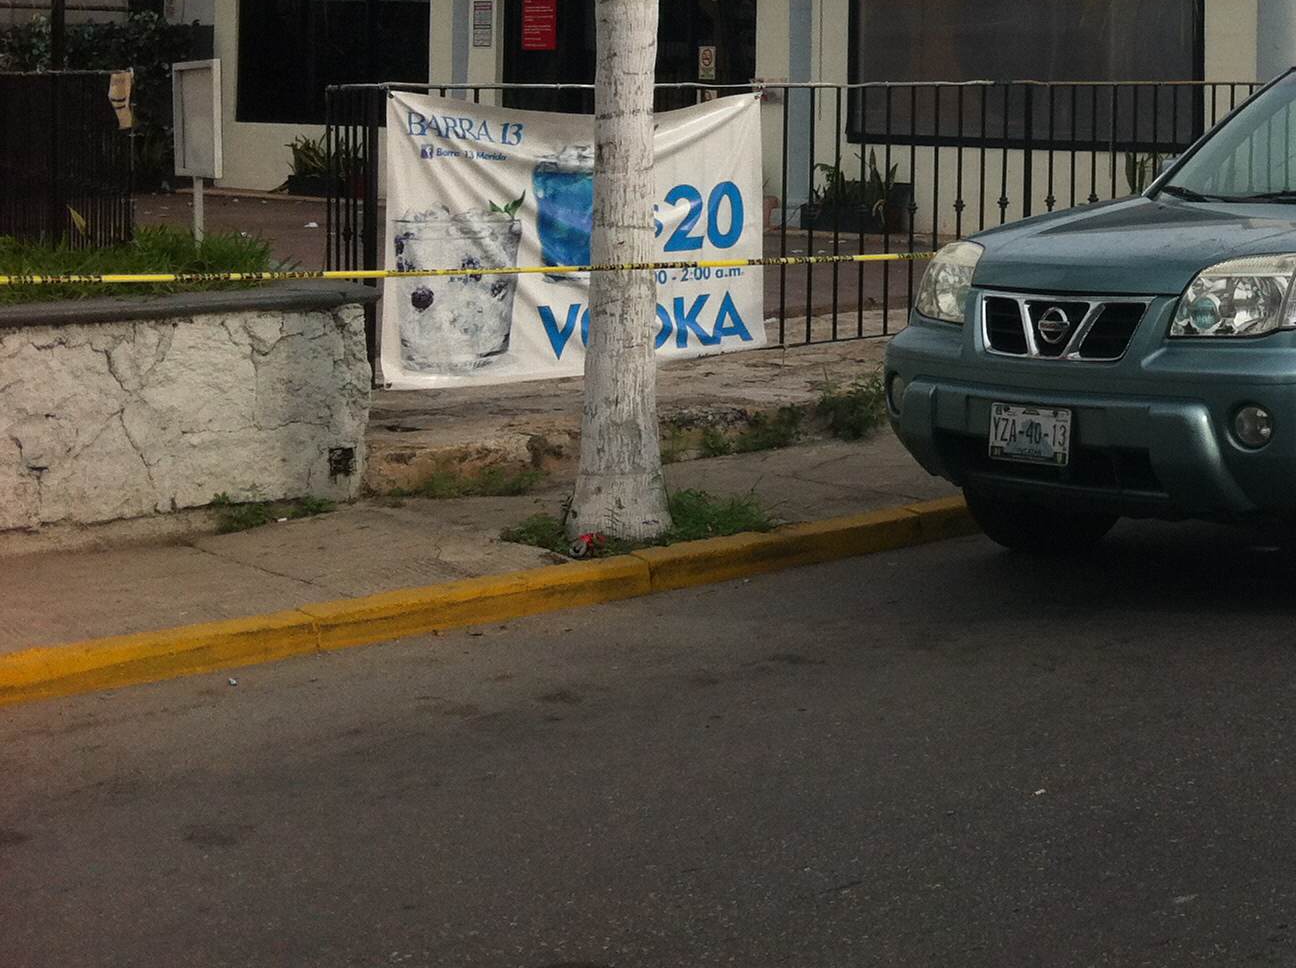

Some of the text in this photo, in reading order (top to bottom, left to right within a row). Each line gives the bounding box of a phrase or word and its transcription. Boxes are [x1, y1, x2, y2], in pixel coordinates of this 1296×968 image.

[407, 112, 525, 146] BARRA 13
[436, 148, 459, 158] Barra
[993, 416, 1067, 447] YZA-40-13
